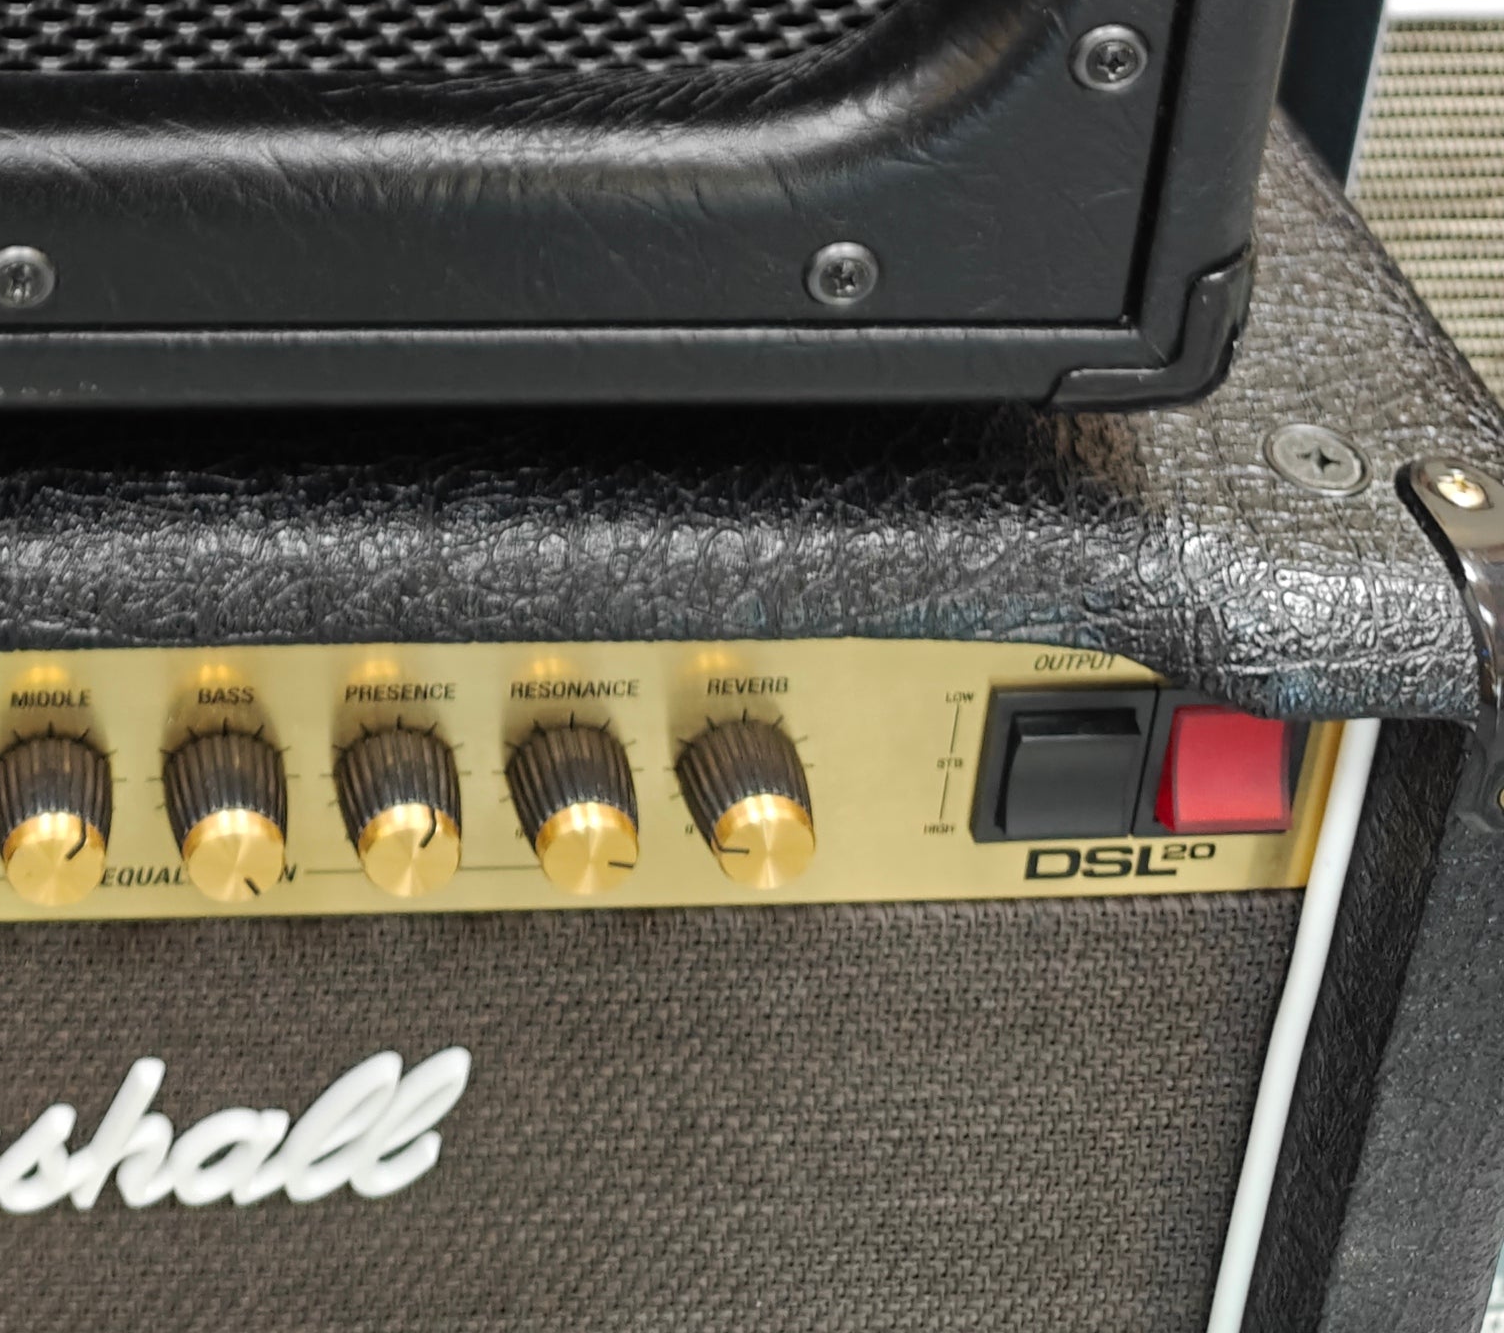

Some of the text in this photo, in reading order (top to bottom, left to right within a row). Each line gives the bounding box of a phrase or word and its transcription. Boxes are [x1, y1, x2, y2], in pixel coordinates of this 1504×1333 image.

[1034, 653, 1116, 671] OUTPUT
[344, 683, 456, 703] PRESENCE
[510, 680, 639, 699] RESONANCE
[706, 677, 789, 695] REVERB
[9, 690, 91, 709] MIDDLE
[197, 687, 255, 705] BASS
[945, 692, 974, 703] LOW
